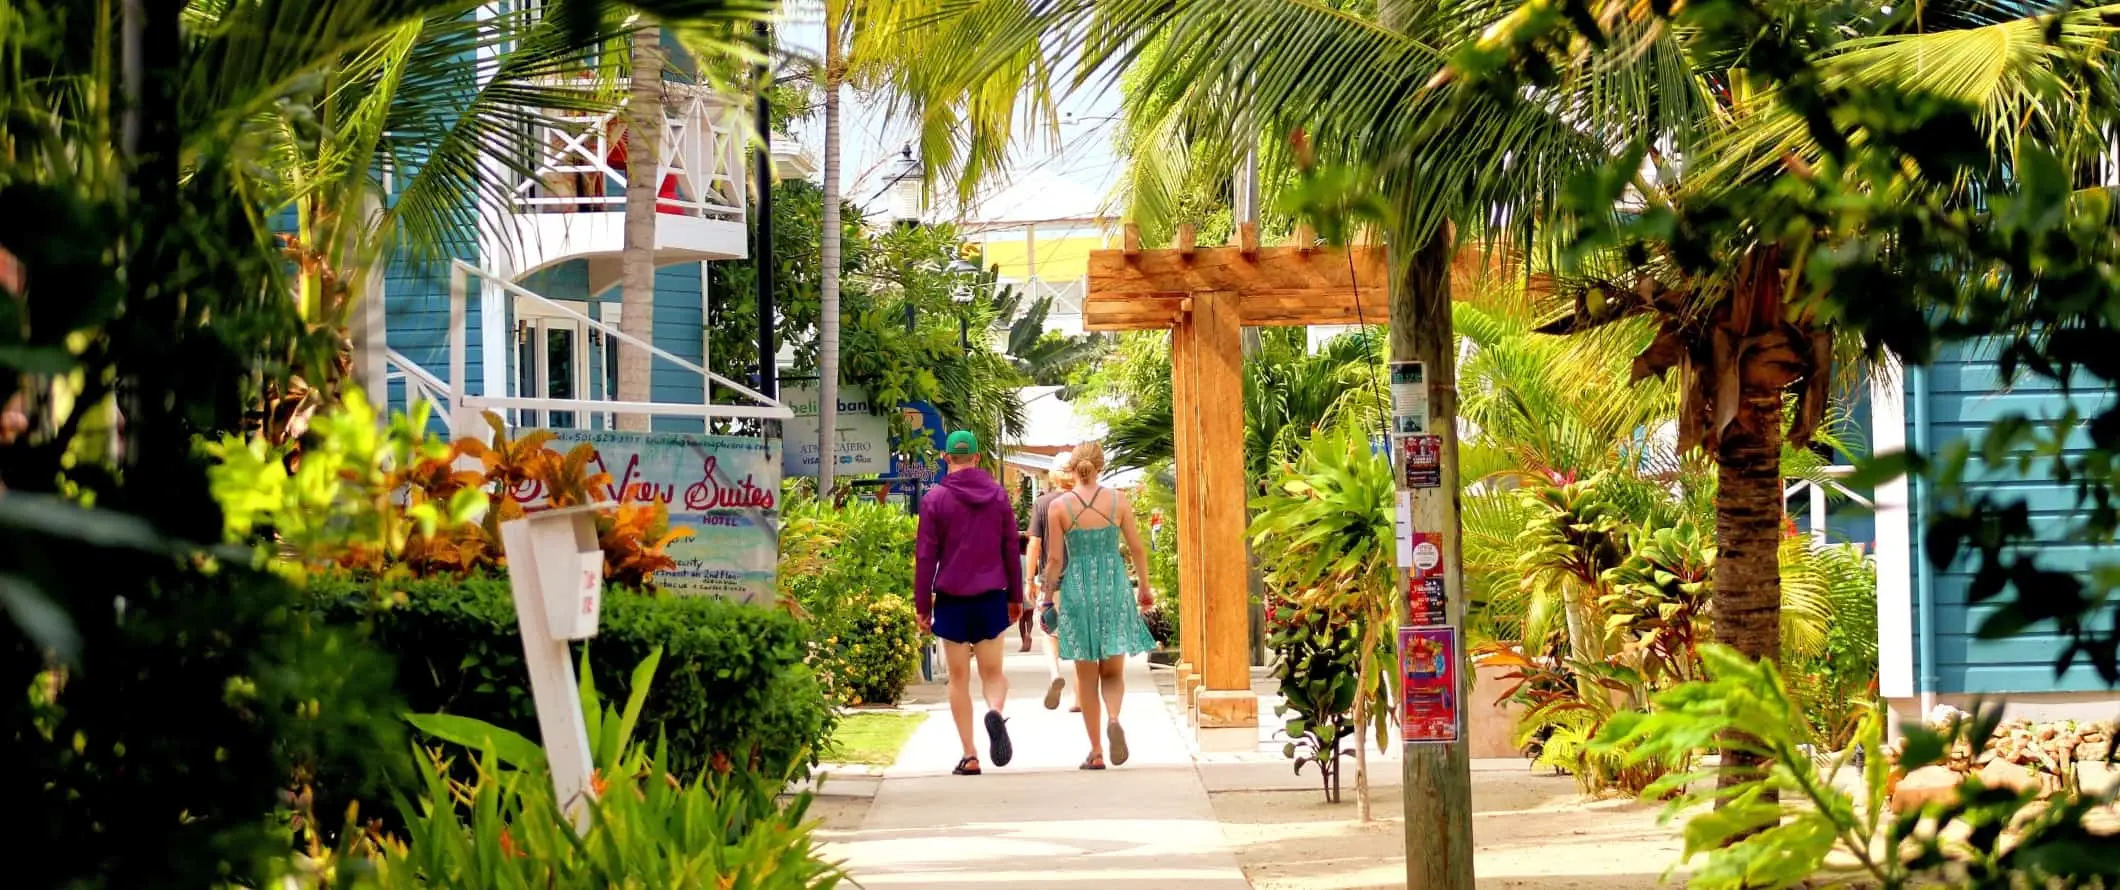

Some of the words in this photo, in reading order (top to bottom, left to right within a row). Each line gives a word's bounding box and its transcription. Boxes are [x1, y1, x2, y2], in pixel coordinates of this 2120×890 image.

[588, 450, 674, 504] Vew
[685, 455, 775, 510] Suites
[703, 515, 738, 527] HOTEL
